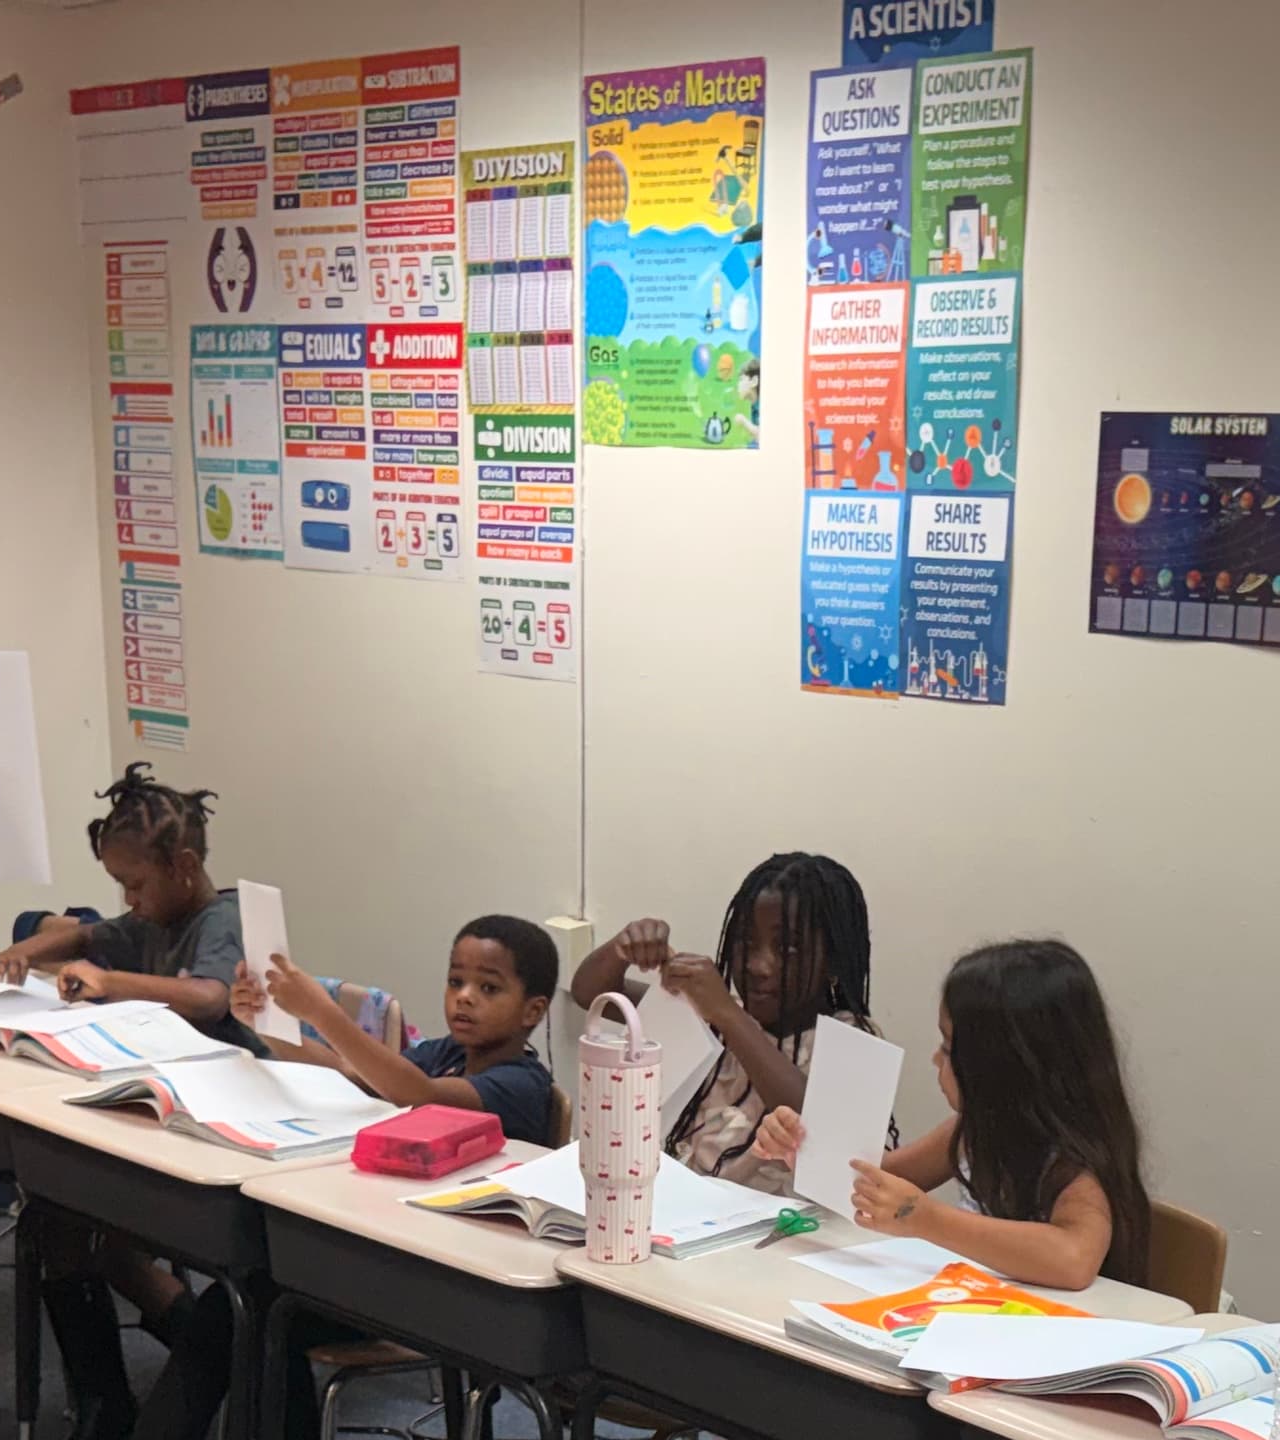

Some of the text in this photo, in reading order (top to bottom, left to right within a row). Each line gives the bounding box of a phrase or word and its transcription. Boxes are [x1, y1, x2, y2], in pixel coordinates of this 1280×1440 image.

[849, 0, 984, 40] A SCIENTIST
[386, 64, 456, 90] SUBTRACTION
[847, 77, 876, 101] ASK
[925, 64, 1022, 97] CONDUCT AN
[205, 83, 268, 109] PARENTHESES
[589, 69, 763, 118] States of Matter
[822, 105, 901, 135] QUESTIONS
[922, 97, 1020, 127] EXPERIMENT
[591, 125, 624, 147] Solid
[473, 153, 565, 182] DIVISION
[373, 275, 387, 298] 5
[406, 274, 418, 297] 2
[438, 272, 450, 295] 3
[830, 299, 881, 321] GATHER
[930, 289, 997, 313] OBSERVE &
[812, 325, 899, 347] INFORMATION
[917, 315, 1009, 340] RECORD RESULTS
[305, 333, 362, 361] EQUALS
[393, 334, 457, 360] ADDITION
[589, 345, 620, 364] Gas
[1170, 416, 1268, 436] SOLAR SYSTEM
[503, 426, 571, 454] DIVISION
[827, 503, 878, 524] MAKE A
[934, 503, 982, 525] SHARE
[380, 524, 393, 547] 2
[410, 525, 421, 549] 3
[442, 527, 453, 550] 5
[811, 530, 893, 553] HYPOTHESIS
[926, 531, 987, 555] RESULTS
[914, 562, 971, 578] Communicate
[481, 614, 501, 635] 20
[519, 617, 531, 642] 4
[553, 618, 566, 643] 5
